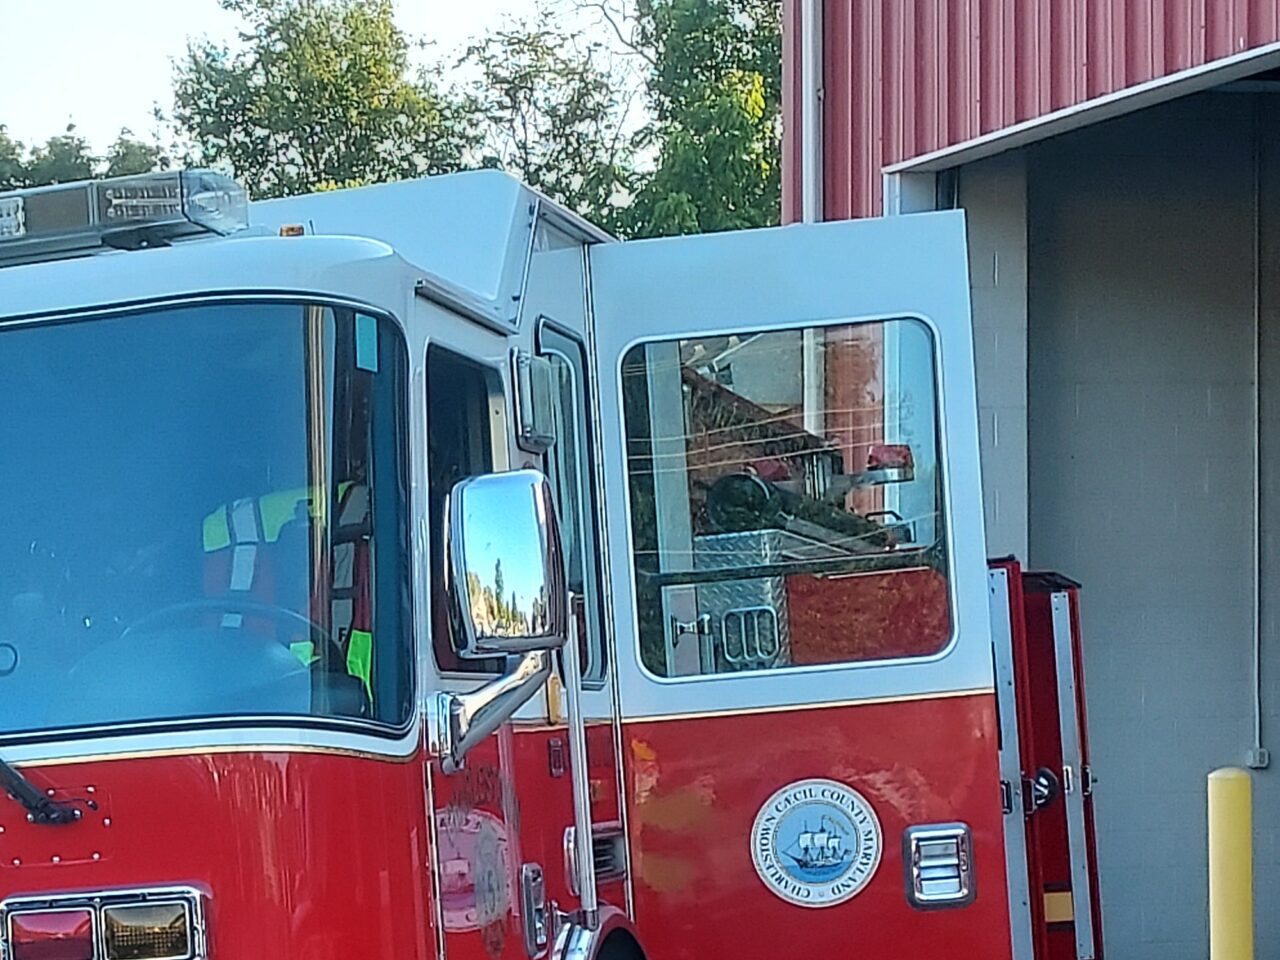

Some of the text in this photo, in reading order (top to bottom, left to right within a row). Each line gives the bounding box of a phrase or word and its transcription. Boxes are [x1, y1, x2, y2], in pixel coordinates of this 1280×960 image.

[821, 788, 869, 824] COUNTY
[758, 815, 811, 898] CHARLESTOWN
[831, 829, 875, 896] MARYLAND
